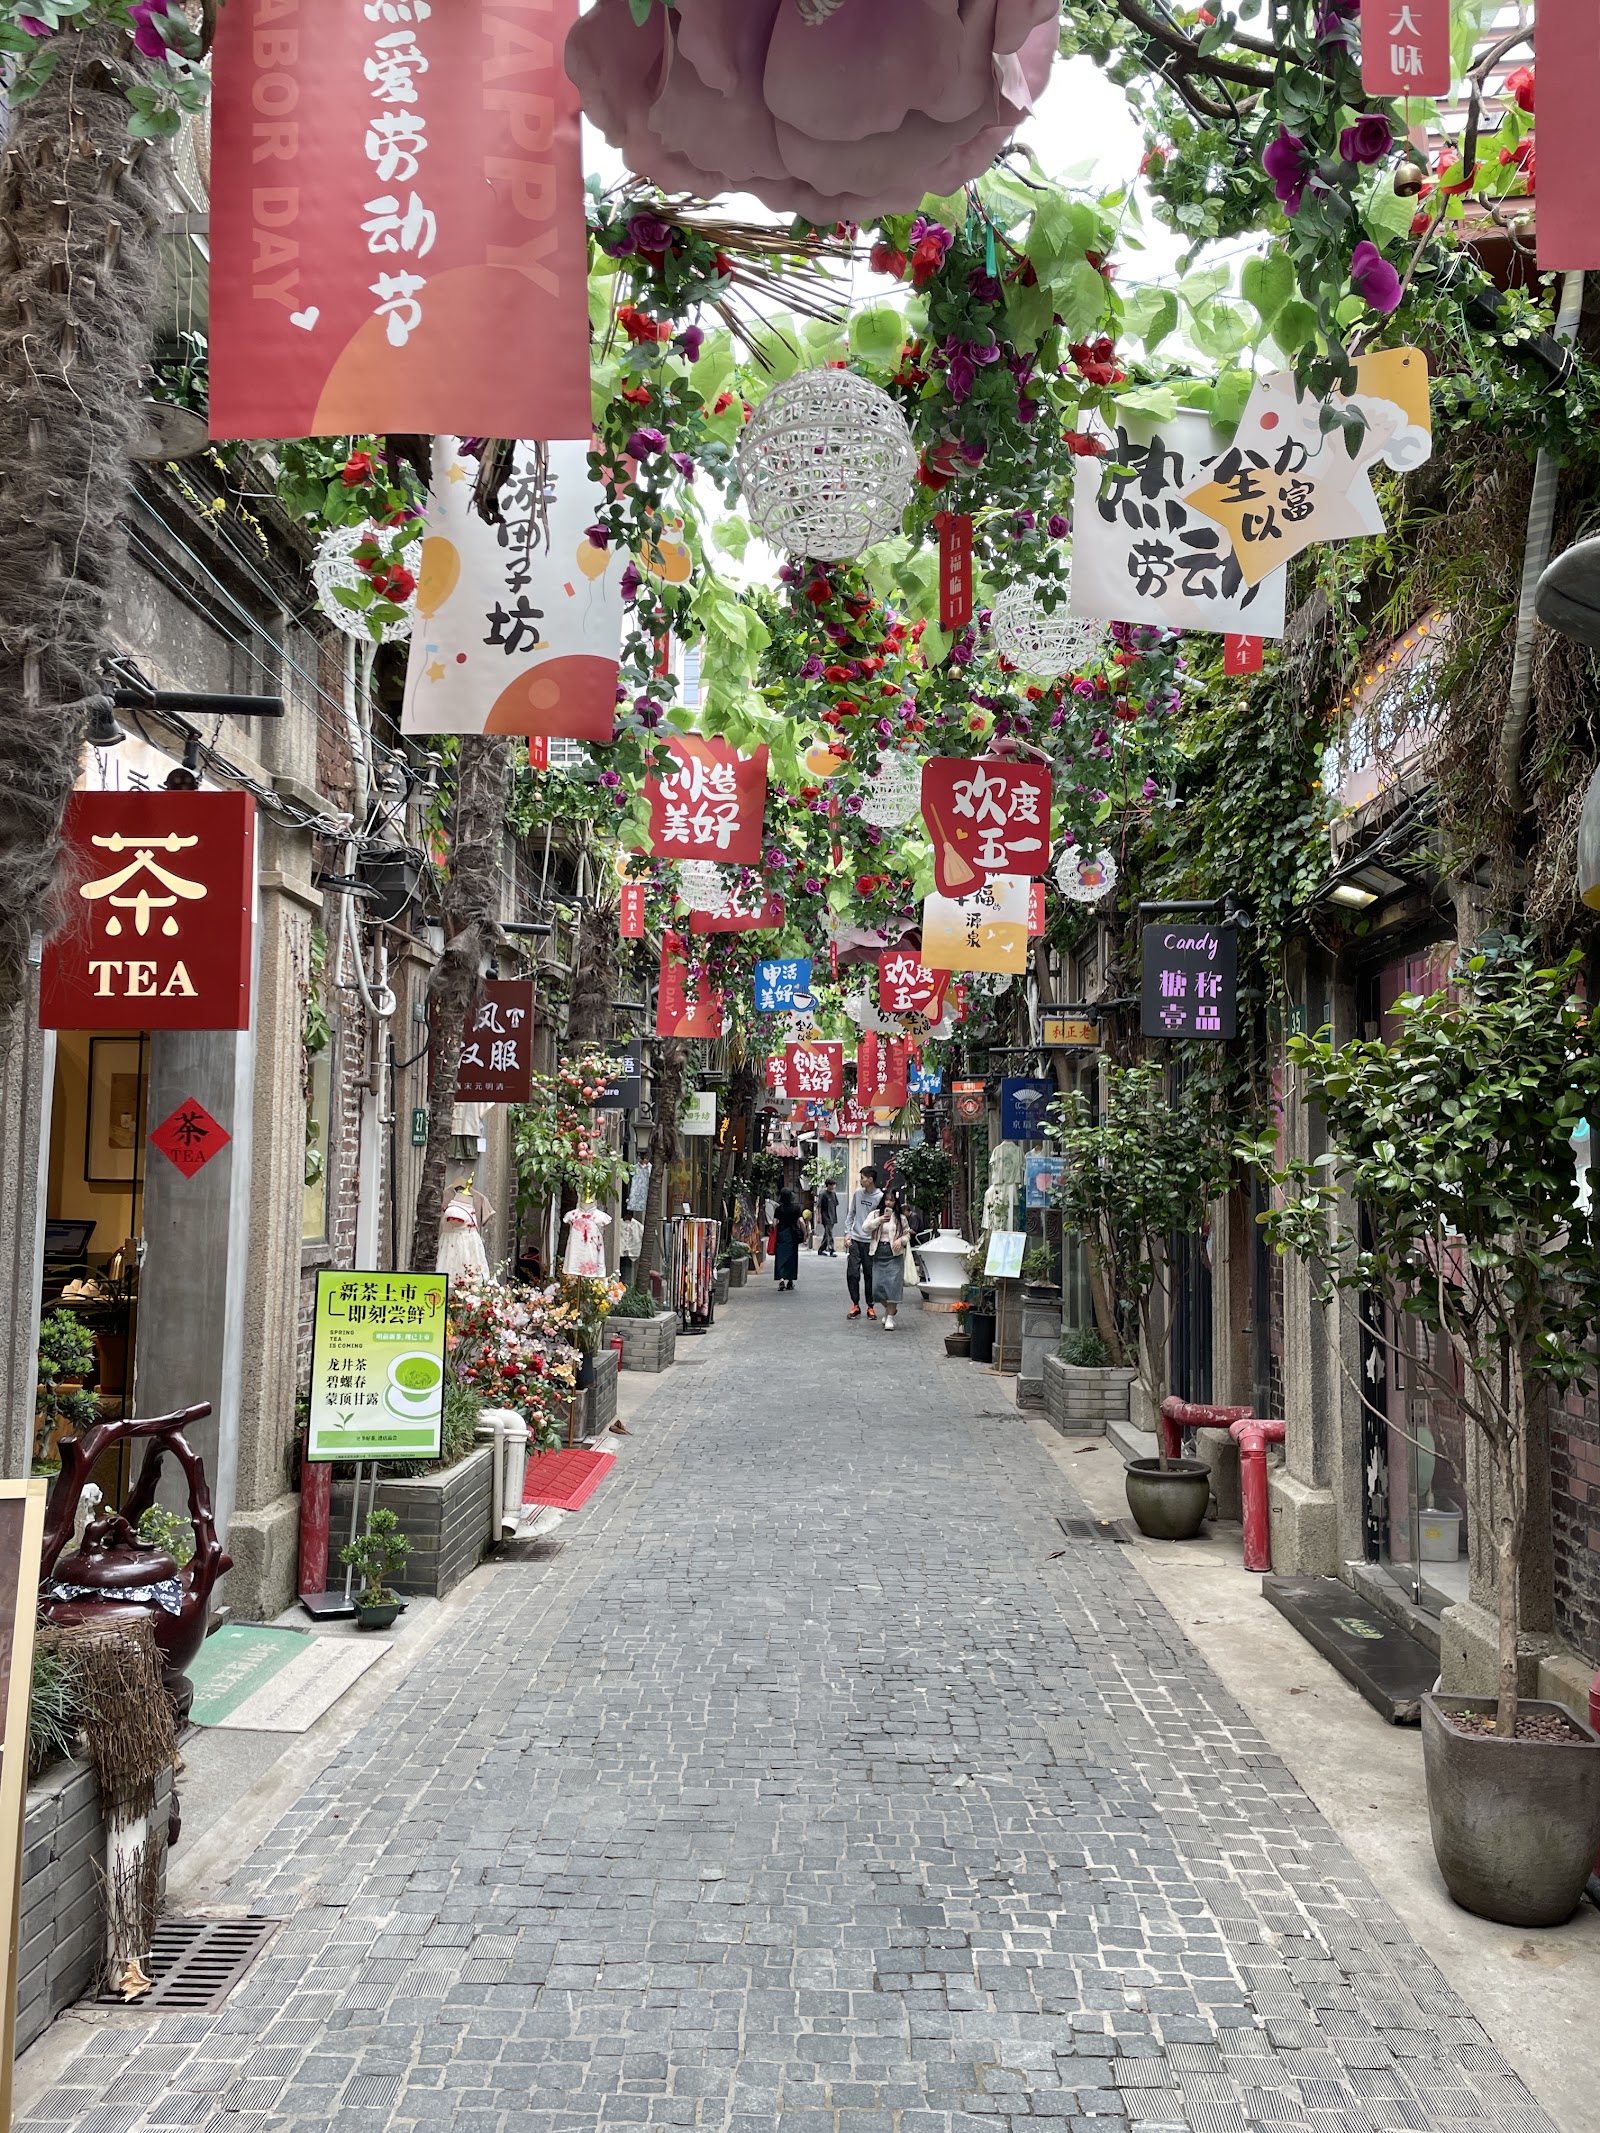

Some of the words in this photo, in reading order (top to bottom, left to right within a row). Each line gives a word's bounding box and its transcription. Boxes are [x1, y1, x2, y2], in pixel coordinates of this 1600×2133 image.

[480, 0, 561, 299] APPY
[252, 187, 302, 316] DAY
[1213, 434, 1308, 504] 全力
[1241, 479, 1316, 541] 以富
[949, 531, 963, 618] 五福临门
[952, 765, 1042, 826] 欢度
[660, 801, 741, 850] 美好
[972, 827, 1043, 868] 五一
[80, 832, 208, 936] 茶
[1164, 932, 1219, 961] Candy
[88, 960, 198, 997] TEA
[762, 963, 798, 988] 申活
[884, 954, 934, 986] 欢度
[760, 984, 794, 1009] 美好
[892, 986, 931, 1010] 五一
[1291, 1010, 1301, 1034] 35
[793, 1049, 831, 1073] 创造
[798, 1071, 833, 1092] 美好
[172, 1111, 209, 1147] 茶
[416, 1114, 424, 1132] 27
[172, 1150, 207, 1163] TEA
[339, 1282, 418, 1303] 新茶上市
[348, 1304, 425, 1325] 即刻尝鲜
[327, 1358, 368, 1372] 龙井茶
[326, 1375, 367, 1389] 碧螺春
[325, 1392, 379, 1406] 蒙顶甘露
